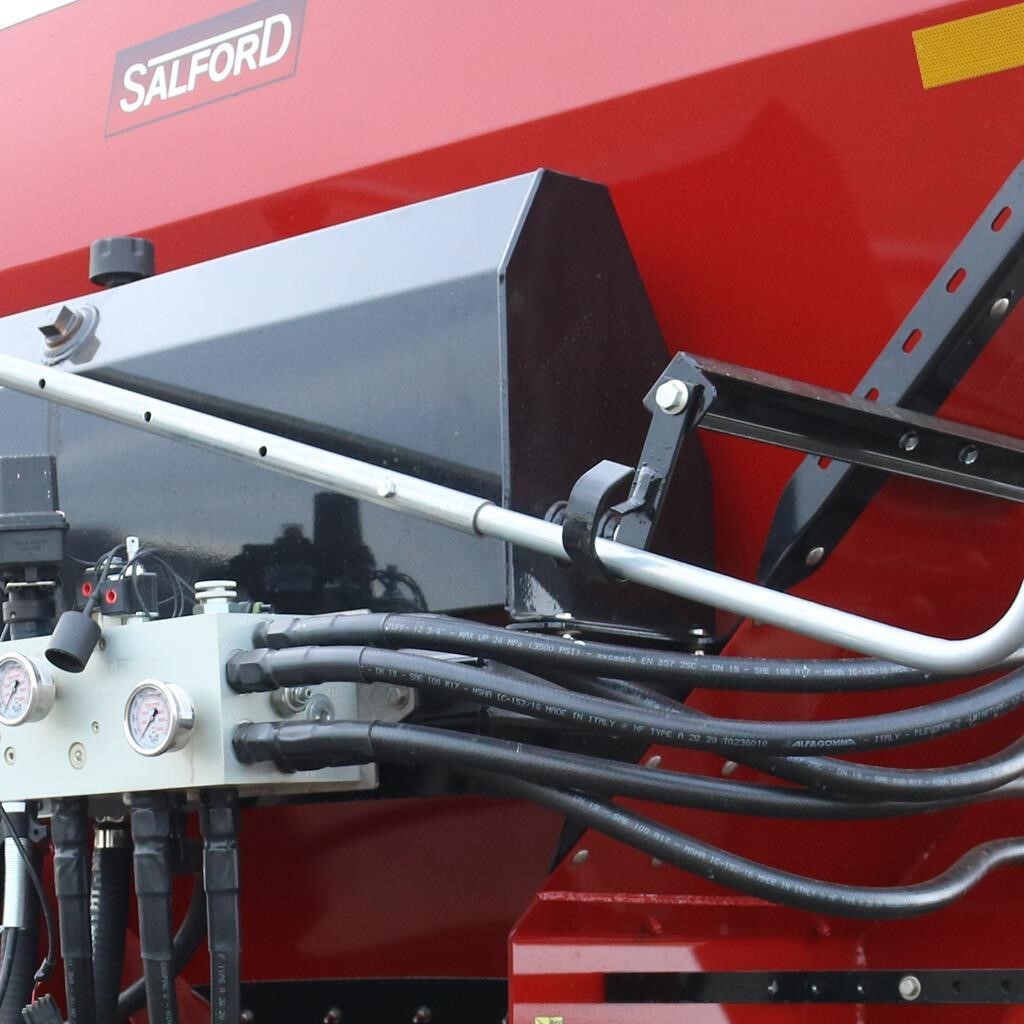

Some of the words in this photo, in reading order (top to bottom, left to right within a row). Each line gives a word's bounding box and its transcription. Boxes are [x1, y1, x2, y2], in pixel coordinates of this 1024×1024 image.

[119, 13, 293, 113] SALFORD
[596, 653, 636, 664] exceeds
[640, 656, 654, 665] EN
[650, 727, 673, 739] TYPE
